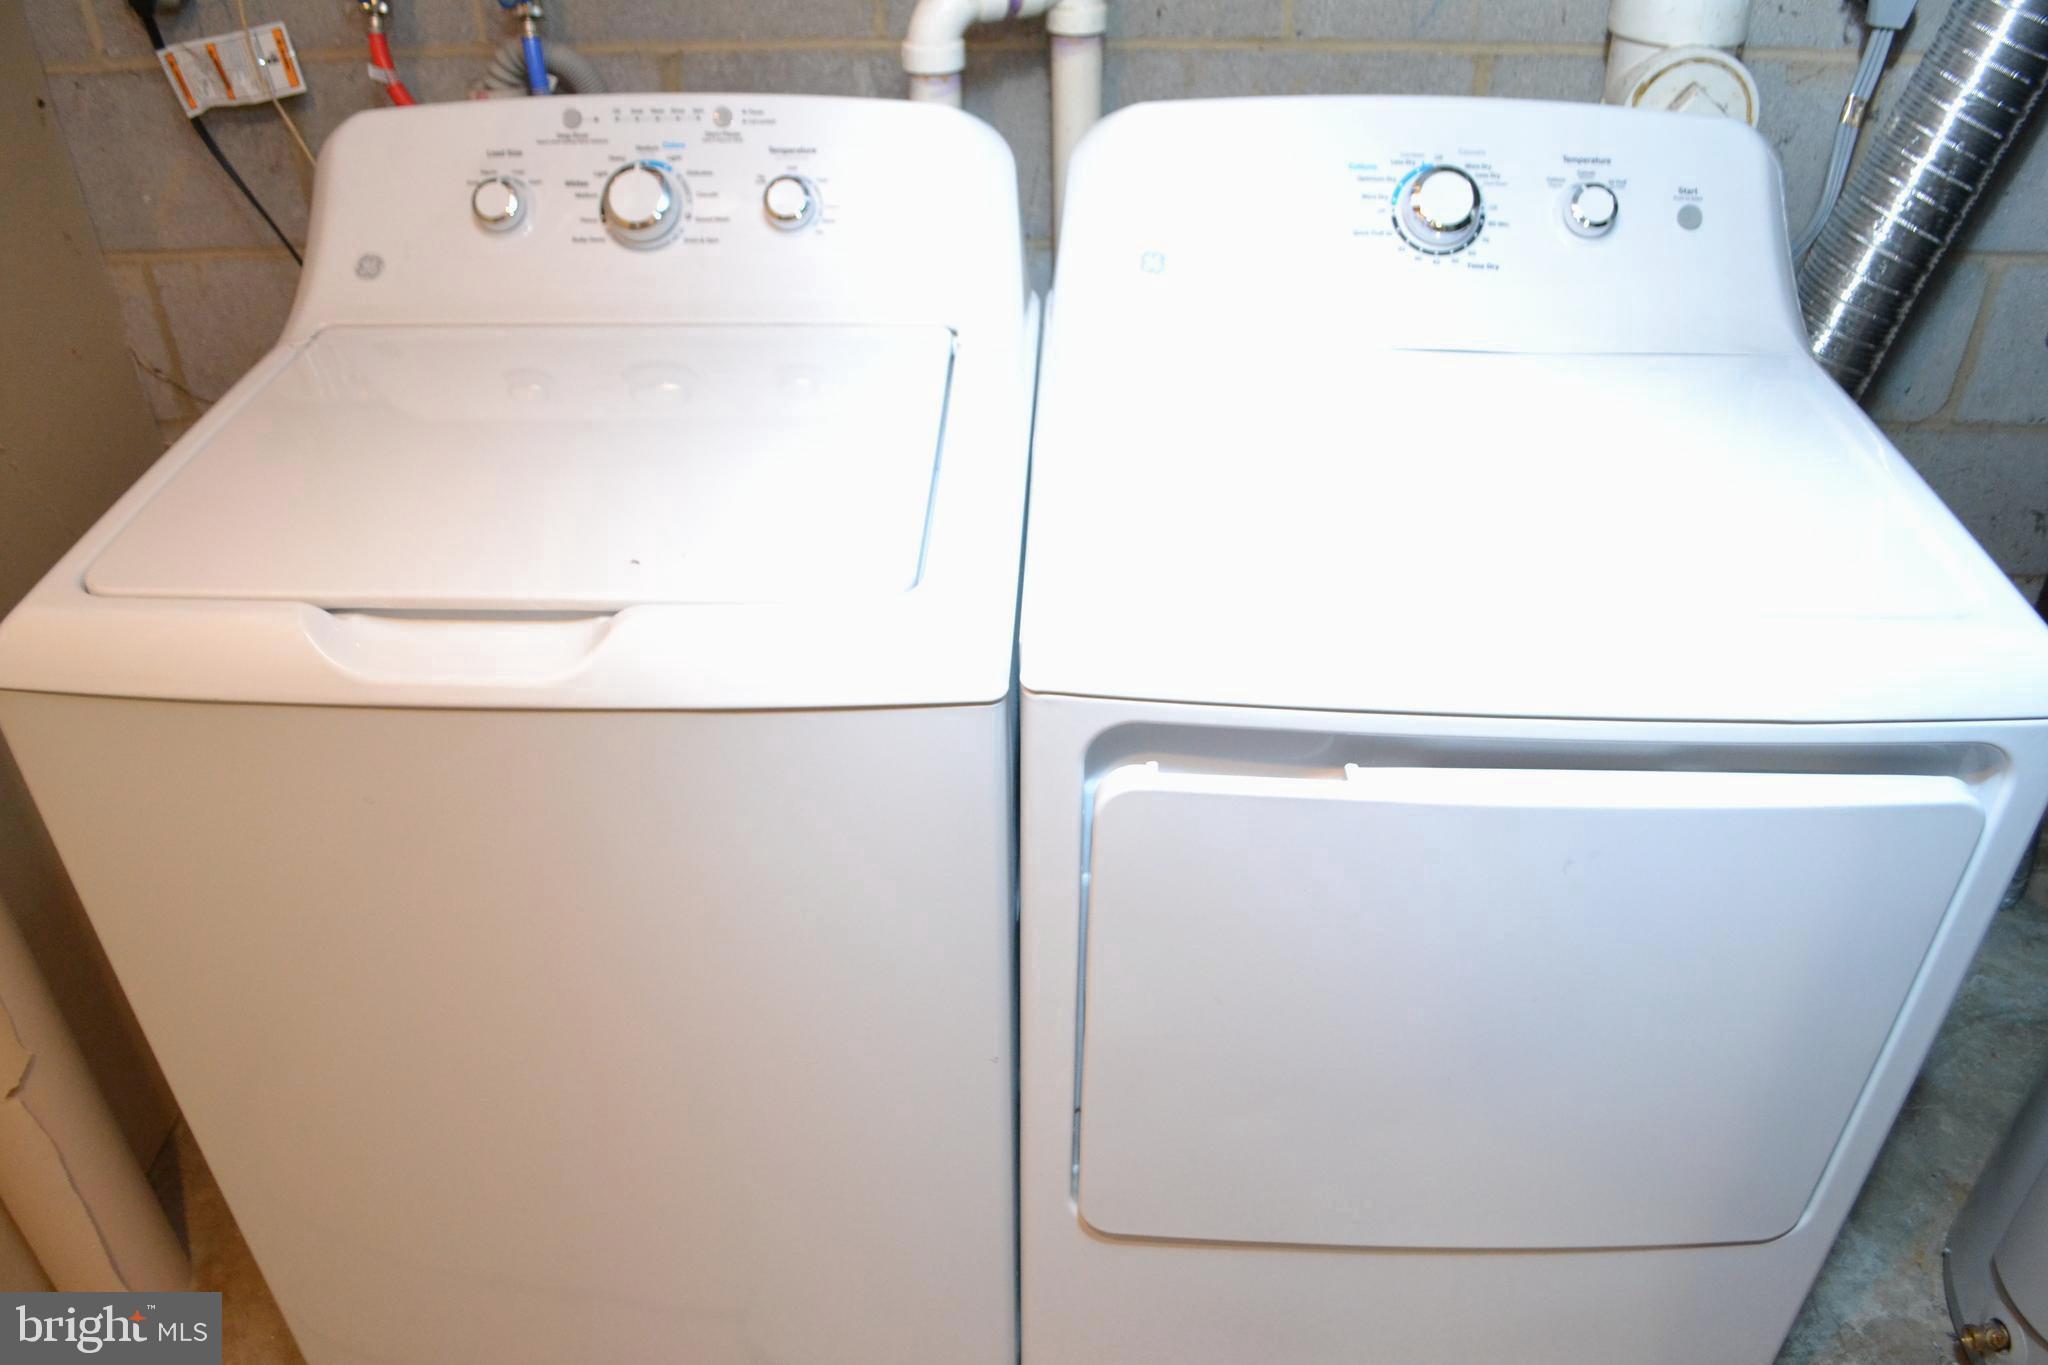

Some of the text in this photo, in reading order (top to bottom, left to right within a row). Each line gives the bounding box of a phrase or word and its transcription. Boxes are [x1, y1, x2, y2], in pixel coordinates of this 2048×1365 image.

[768, 146, 817, 156] Temperature
[1562, 154, 1612, 166] Temperature
[1677, 186, 1698, 194] Start
